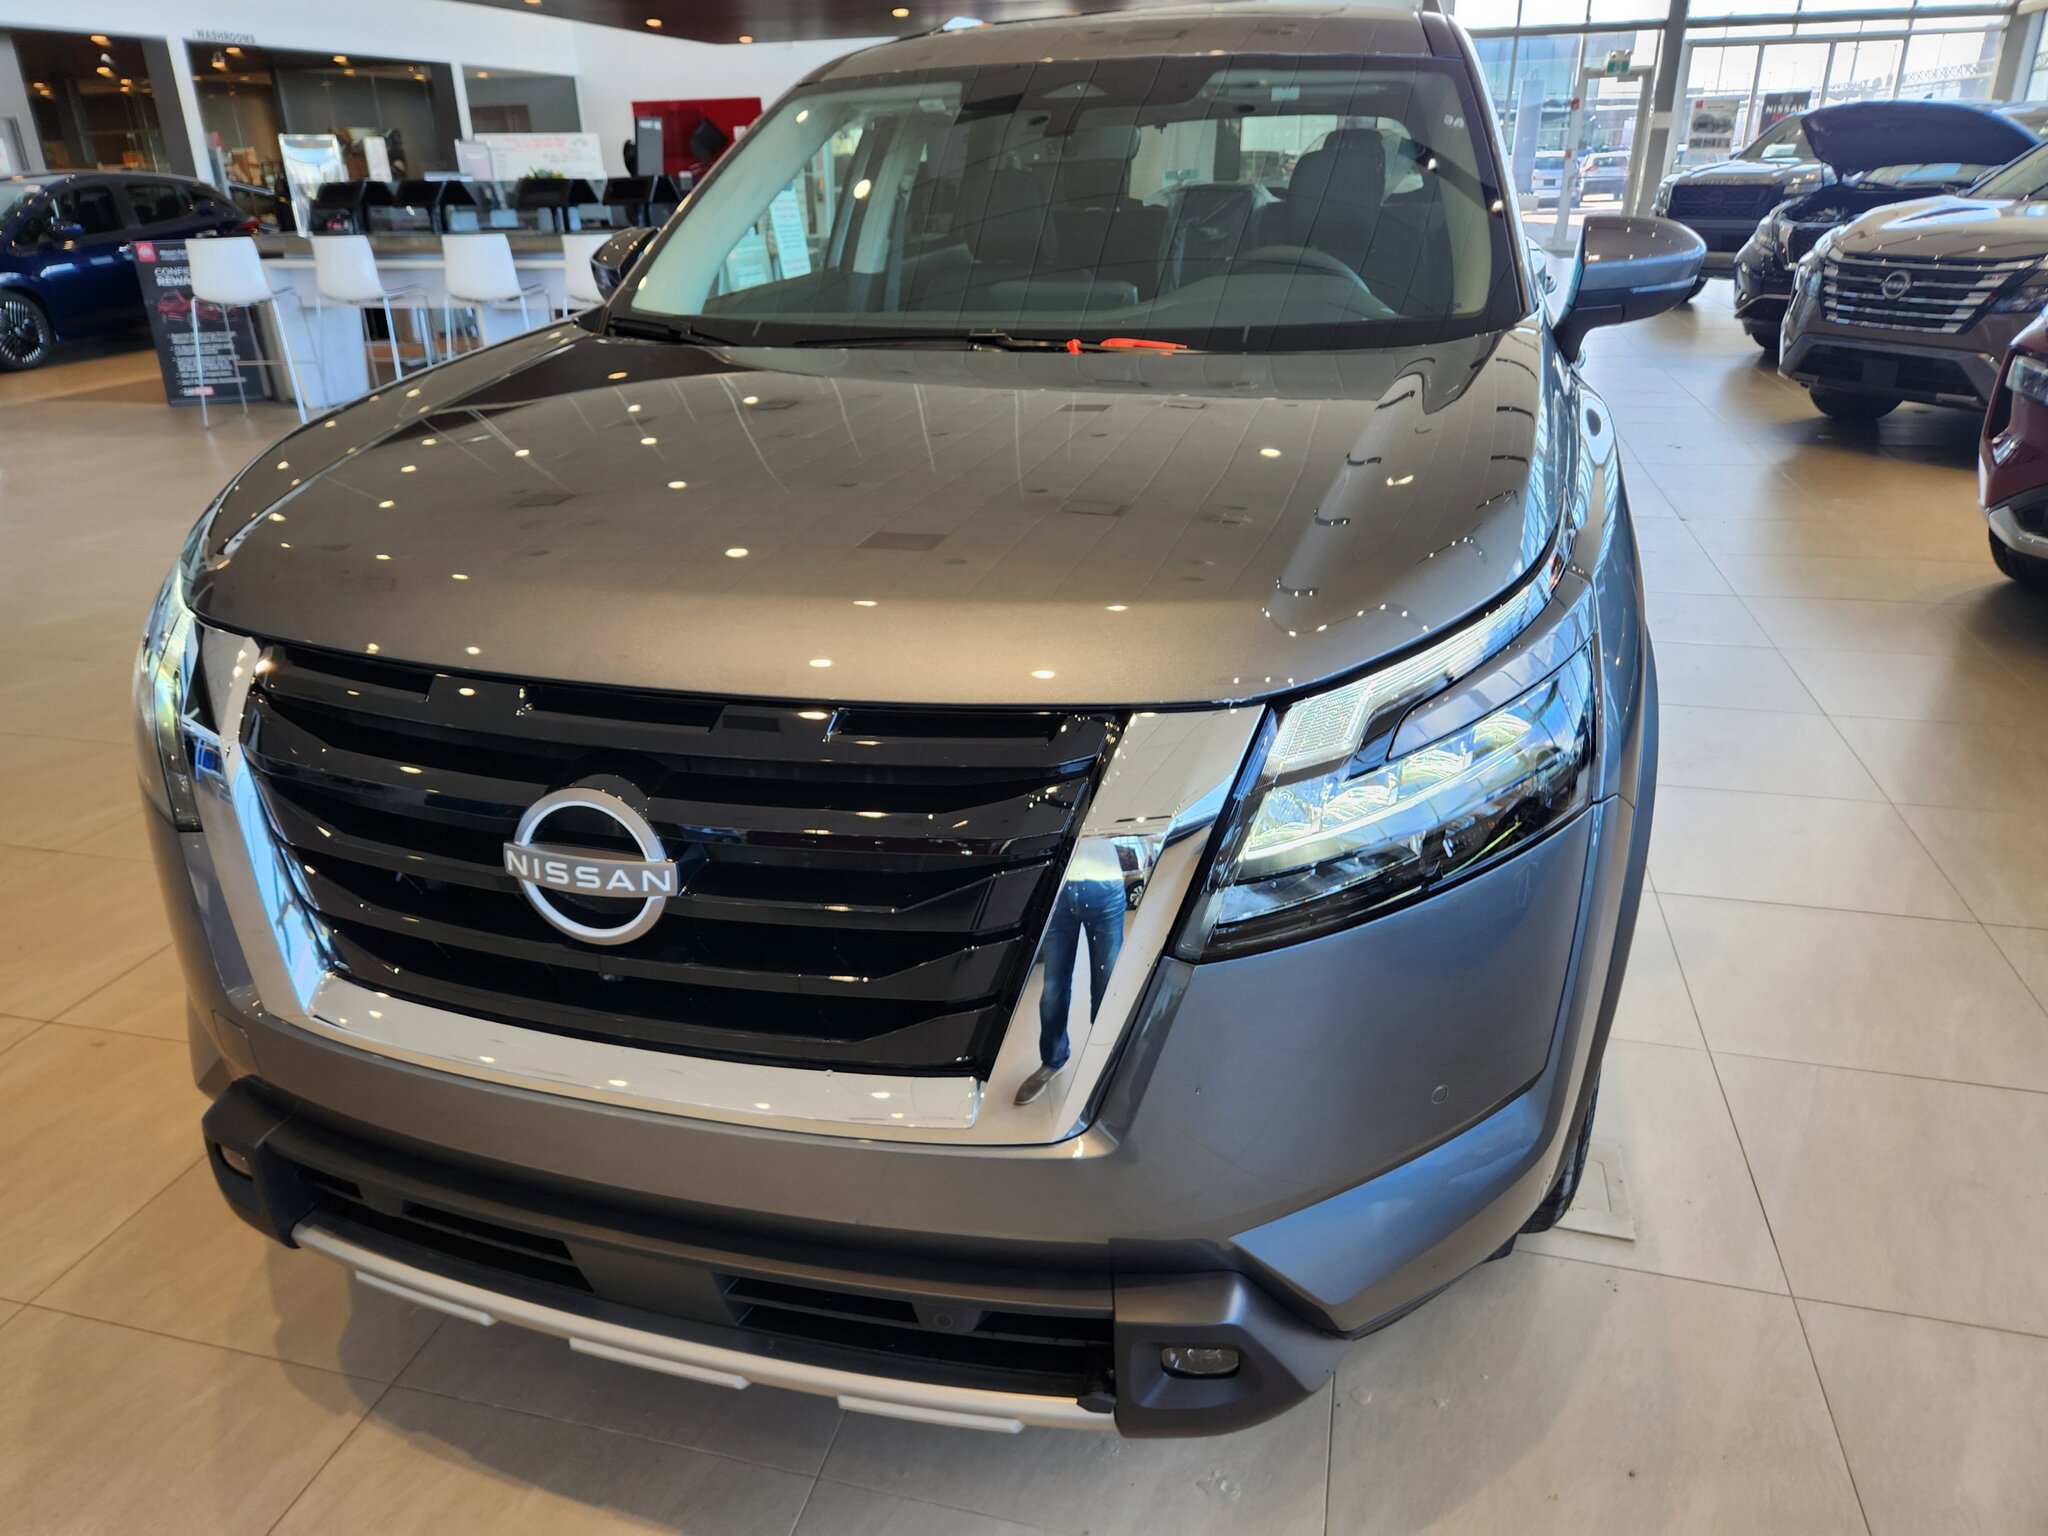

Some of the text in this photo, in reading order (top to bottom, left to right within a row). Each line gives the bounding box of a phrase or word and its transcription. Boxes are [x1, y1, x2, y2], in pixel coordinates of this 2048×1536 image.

[196, 28, 257, 44] WASHROOMS
[1765, 103, 1806, 114] NISSAN
[506, 850, 671, 892] NISSAN
